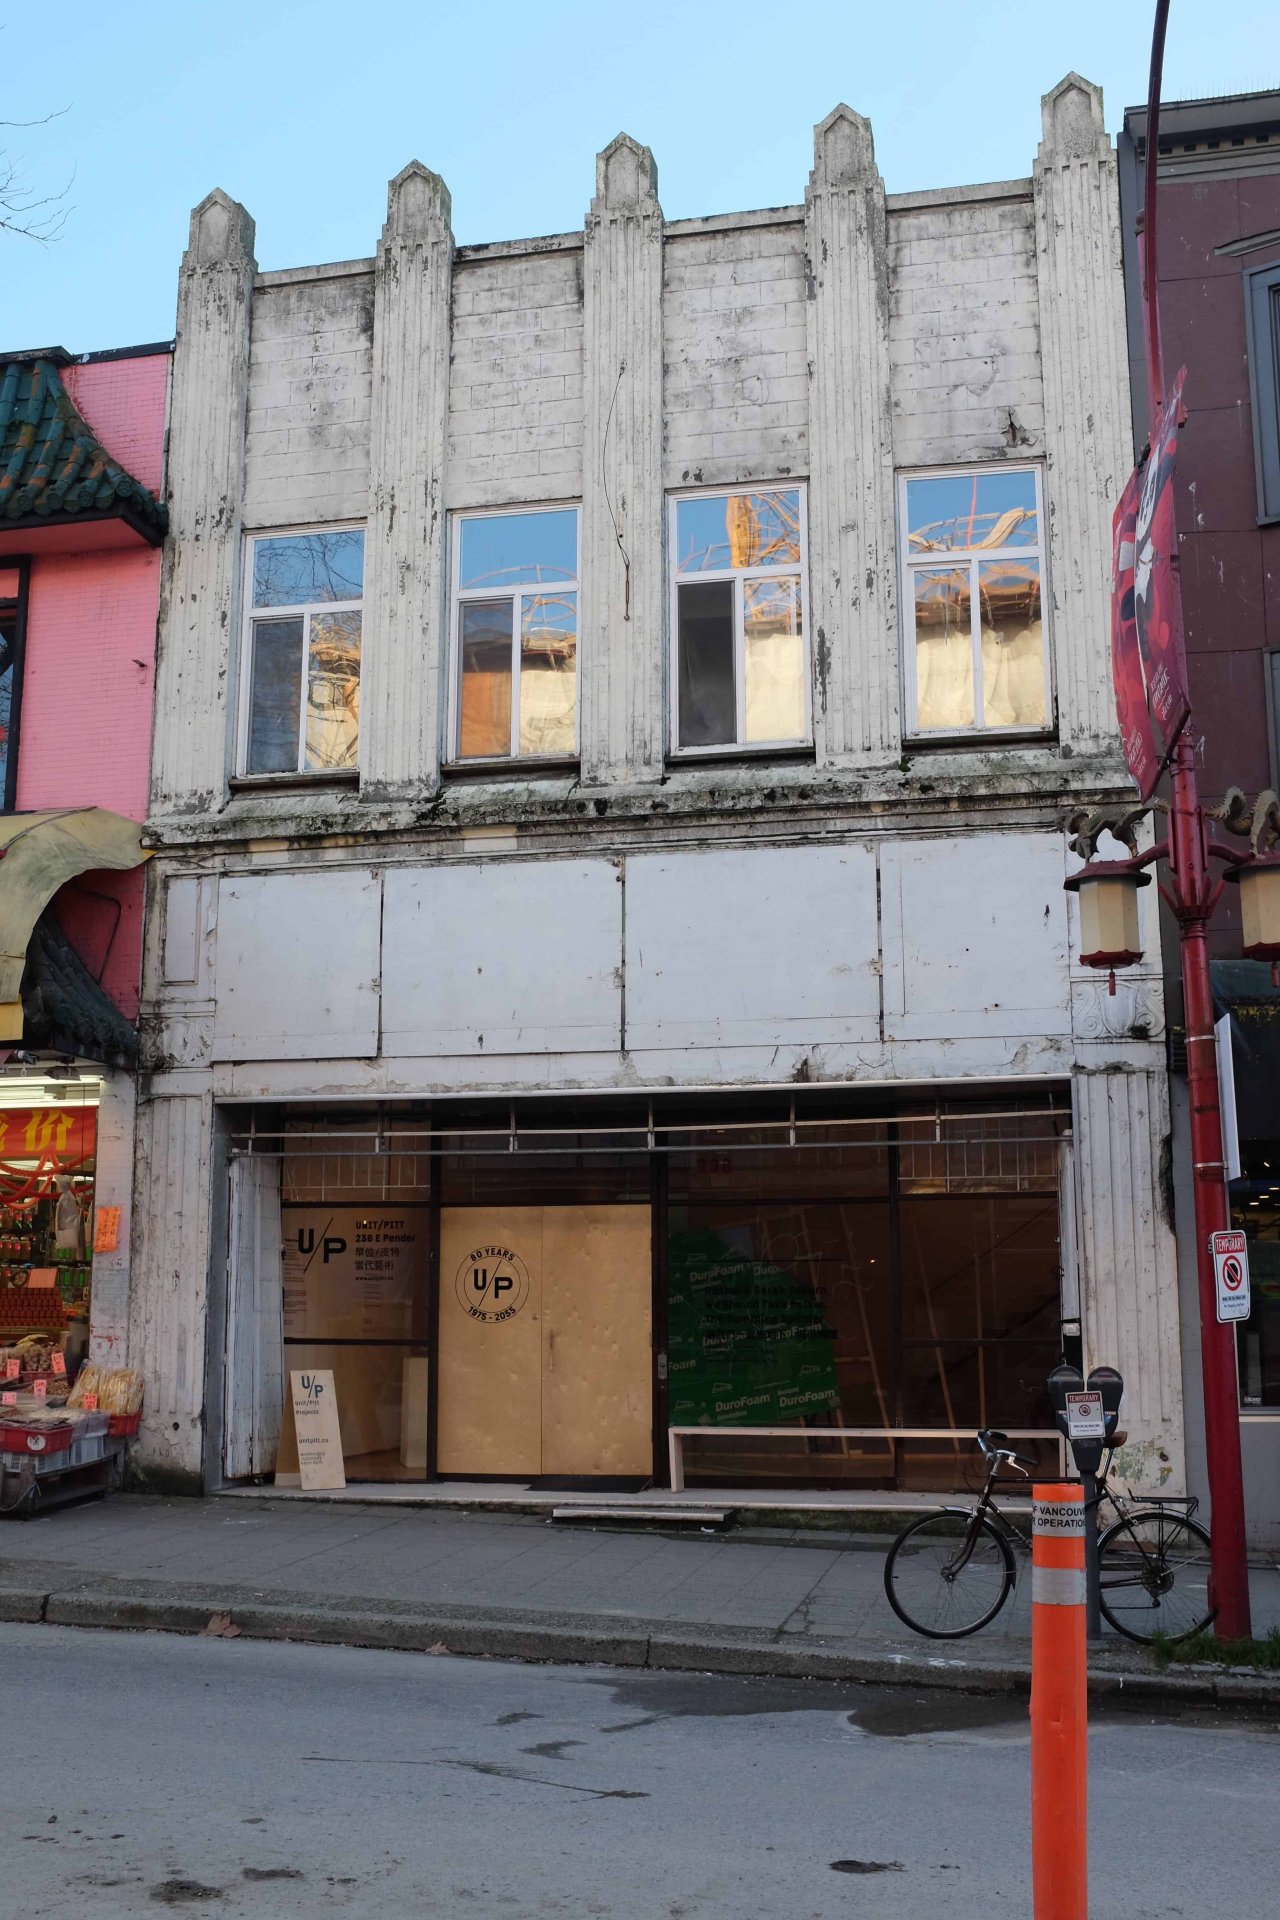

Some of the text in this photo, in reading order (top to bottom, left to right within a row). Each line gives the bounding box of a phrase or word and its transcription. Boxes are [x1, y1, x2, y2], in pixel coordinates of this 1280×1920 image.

[356, 1219, 405, 1231] UNIT/PITT
[356, 1233, 416, 1242] 236 E Pender
[470, 1247, 515, 1262] 80 YEARS
[690, 1264, 745, 1282] DuroFoam
[473, 1259, 513, 1307] U/P
[468, 1306, 487, 1320] 1975
[495, 1306, 516, 1321] 2055
[301, 1375, 324, 1398] U/P
[715, 1392, 771, 1412] DuroFoam
[779, 1388, 835, 1408] DuroFoam
[1069, 1393, 1099, 1402] TEMPORARY
[1038, 1518, 1084, 1527] OPERATIO
